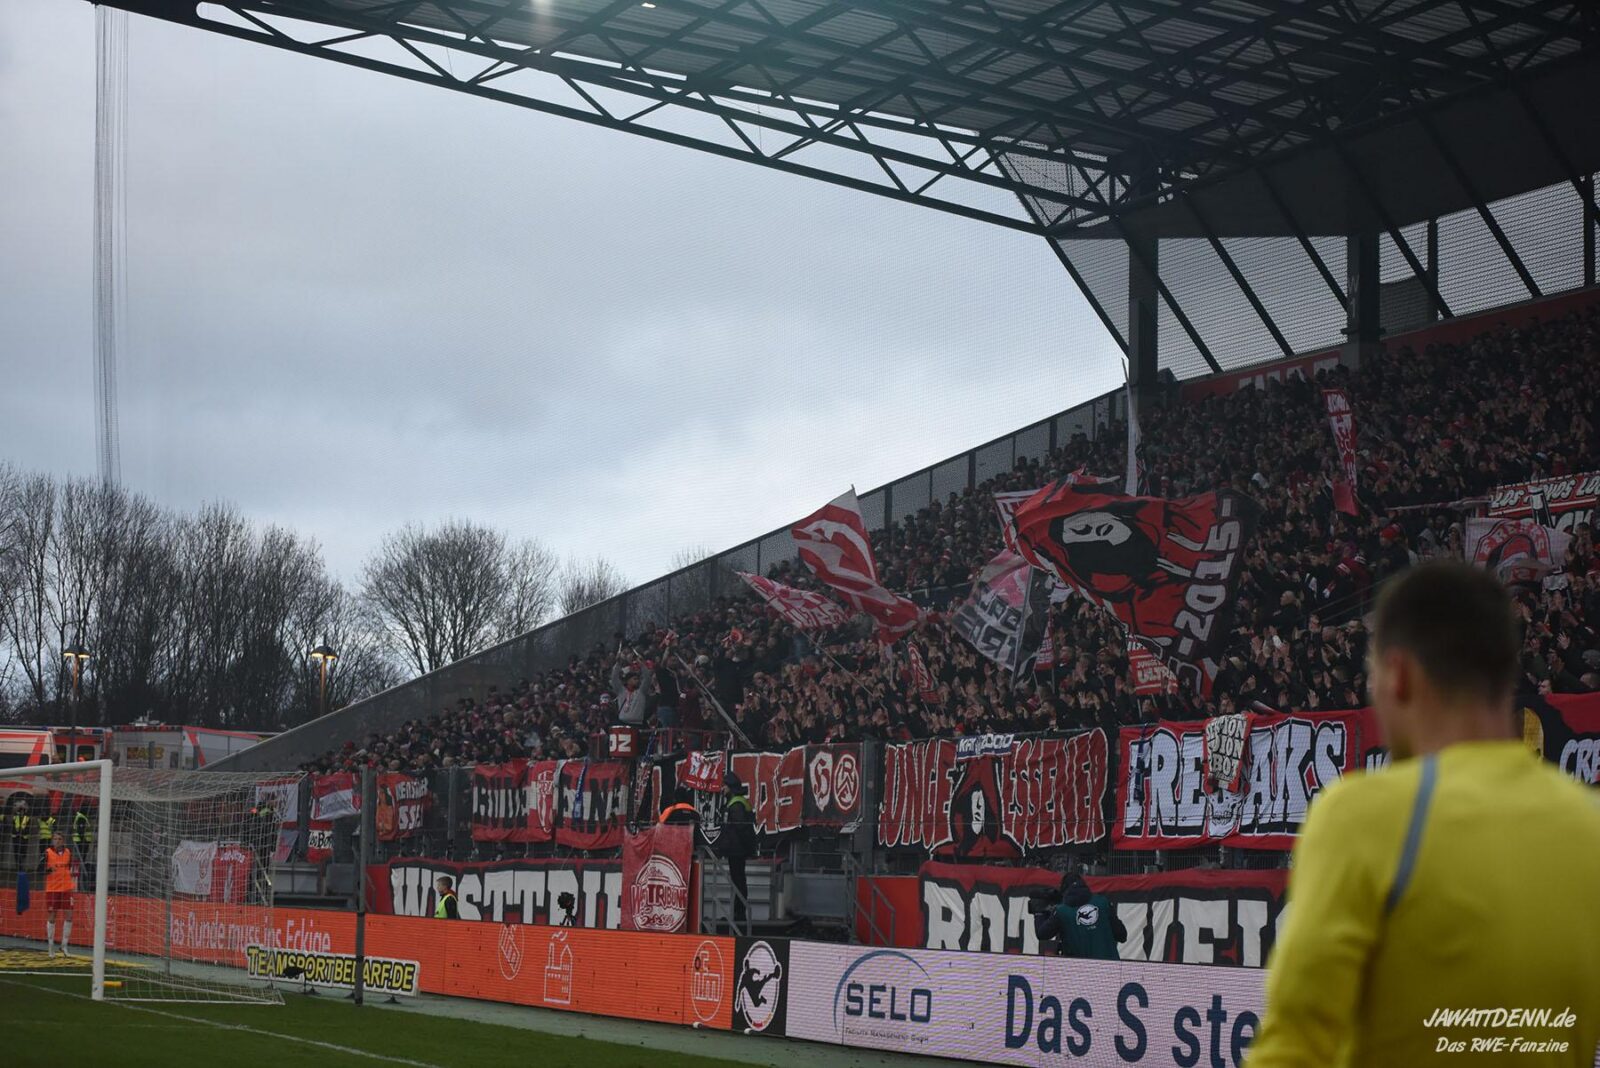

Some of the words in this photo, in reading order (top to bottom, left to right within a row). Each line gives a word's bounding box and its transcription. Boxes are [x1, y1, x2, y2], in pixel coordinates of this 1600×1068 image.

[846, 983, 932, 1023] SELO
[1005, 974, 1093, 1057] Das
[1114, 982, 1149, 1063] S
